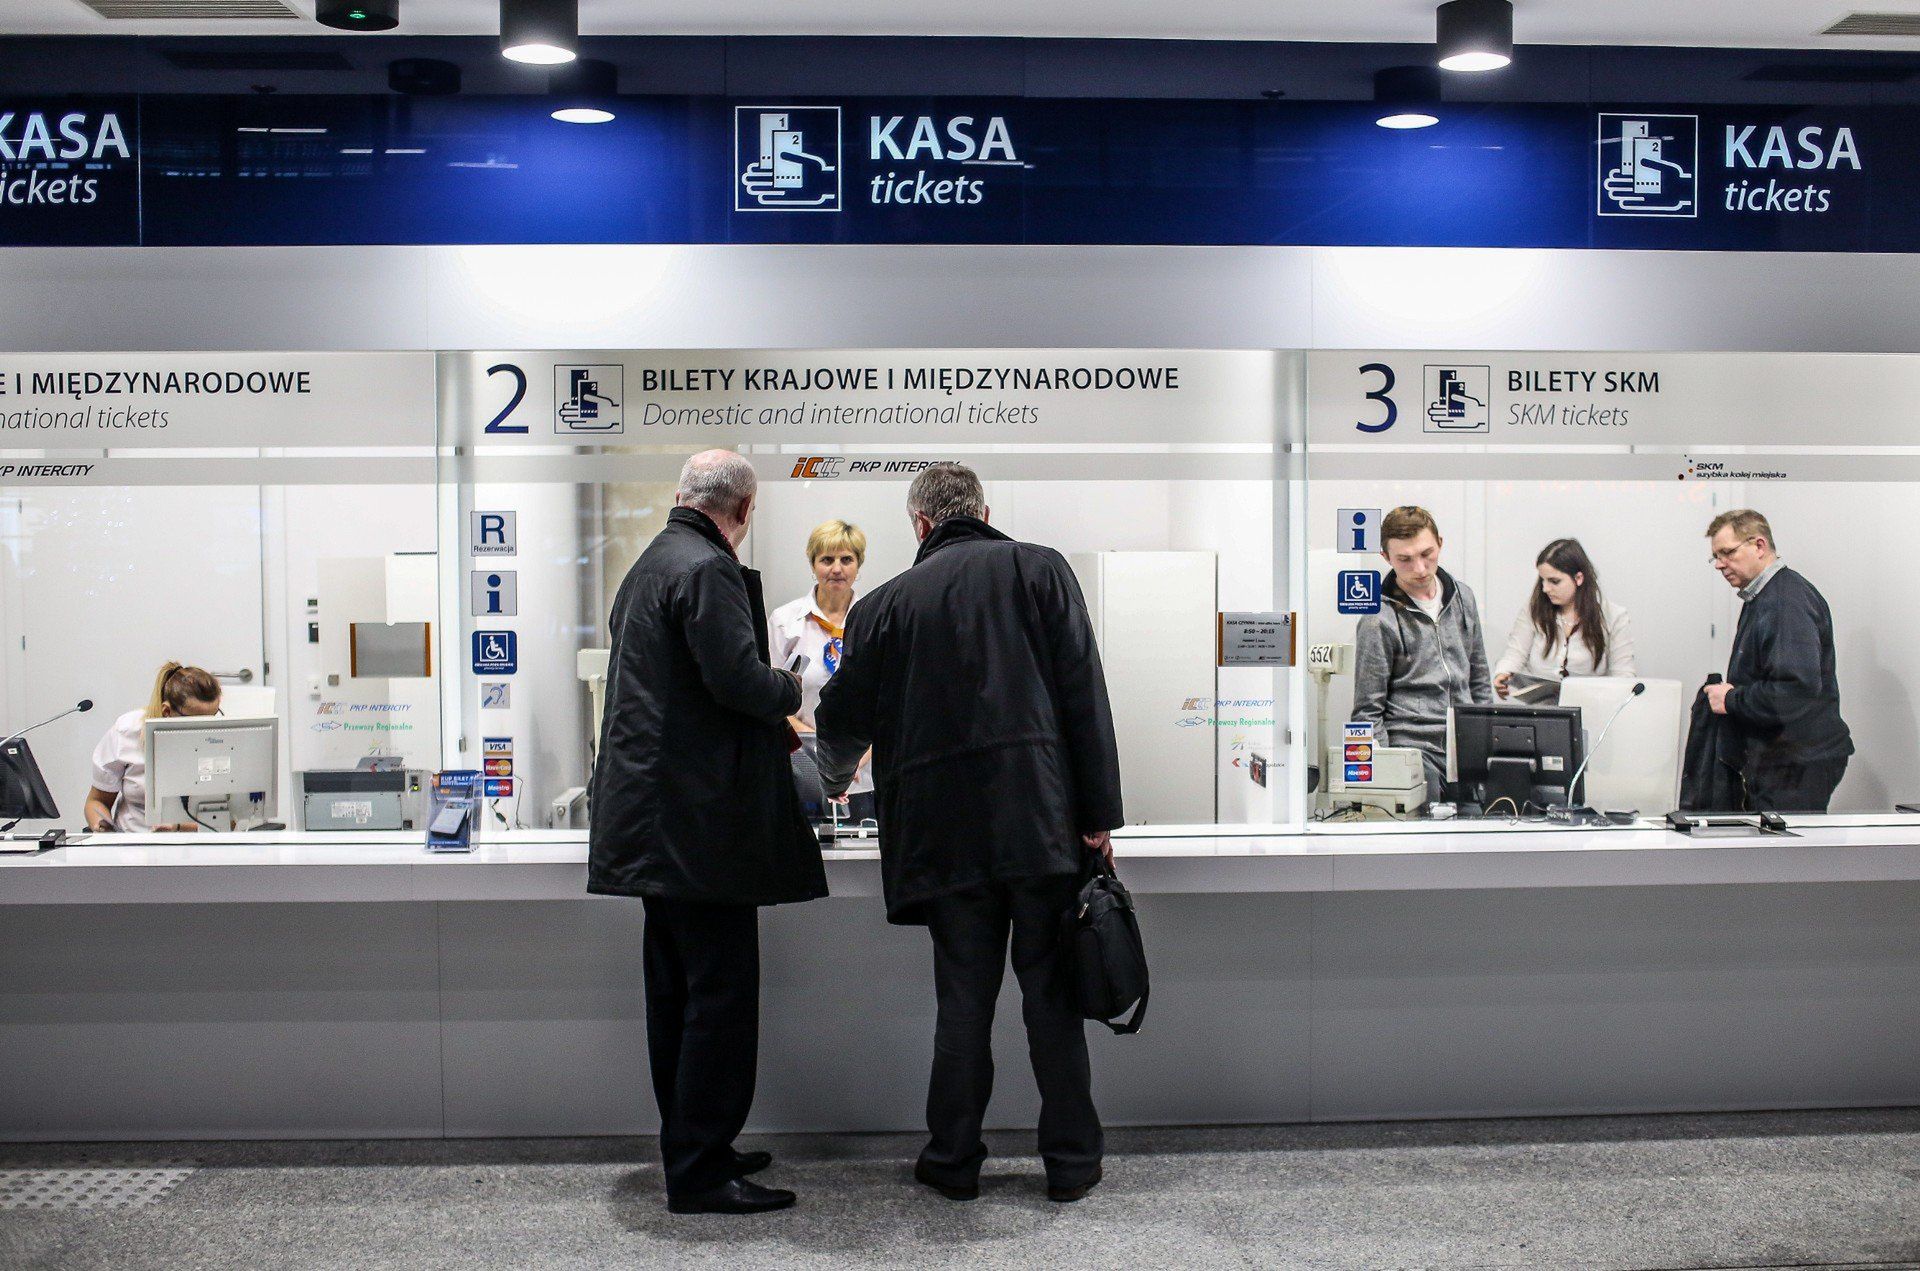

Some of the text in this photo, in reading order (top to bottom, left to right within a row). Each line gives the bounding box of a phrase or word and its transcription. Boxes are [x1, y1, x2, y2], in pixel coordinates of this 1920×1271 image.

[779, 117, 786, 127] 1
[1640, 125, 1646, 134] 1
[792, 135, 800, 145] 2
[870, 115, 1017, 160] KASA
[1652, 142, 1659, 152] 2
[1725, 124, 1862, 170] KASA
[870, 171, 984, 205] tickets
[1725, 179, 1831, 213] tickets
[16, 373, 22, 395] I
[32, 371, 311, 401] MIĘDZYNARODOWE
[642, 367, 1179, 398] BILETY KRAJOWE I MIĘDZYNARODOWE
[1508, 371, 1660, 393] BILETY SKM
[484, 363, 529, 434] 2
[1356, 362, 1398, 434] 3
[97, 405, 169, 429] tickets
[643, 400, 1039, 426] Domestic and international tickets
[1508, 403, 1629, 426] SKM tickets
[16, 464, 95, 477] INTERCITY
[849, 461, 881, 473] PKP
[883, 461, 961, 473] INTER
[1696, 462, 1724, 471] SKM
[1696, 472, 1729, 480] szybka
[1730, 471, 1752, 479] kolej
[480, 514, 506, 544] R
[473, 545, 515, 553] Rezerwacja
[349, 703, 368, 712] PKP
[369, 703, 412, 712] INTERCITY
[1213, 699, 1232, 707] PKP
[1232, 699, 1276, 707] INTERCITY
[1207, 716, 1276, 728] Przewozy Regionalne
[489, 743, 507, 751] VISA
